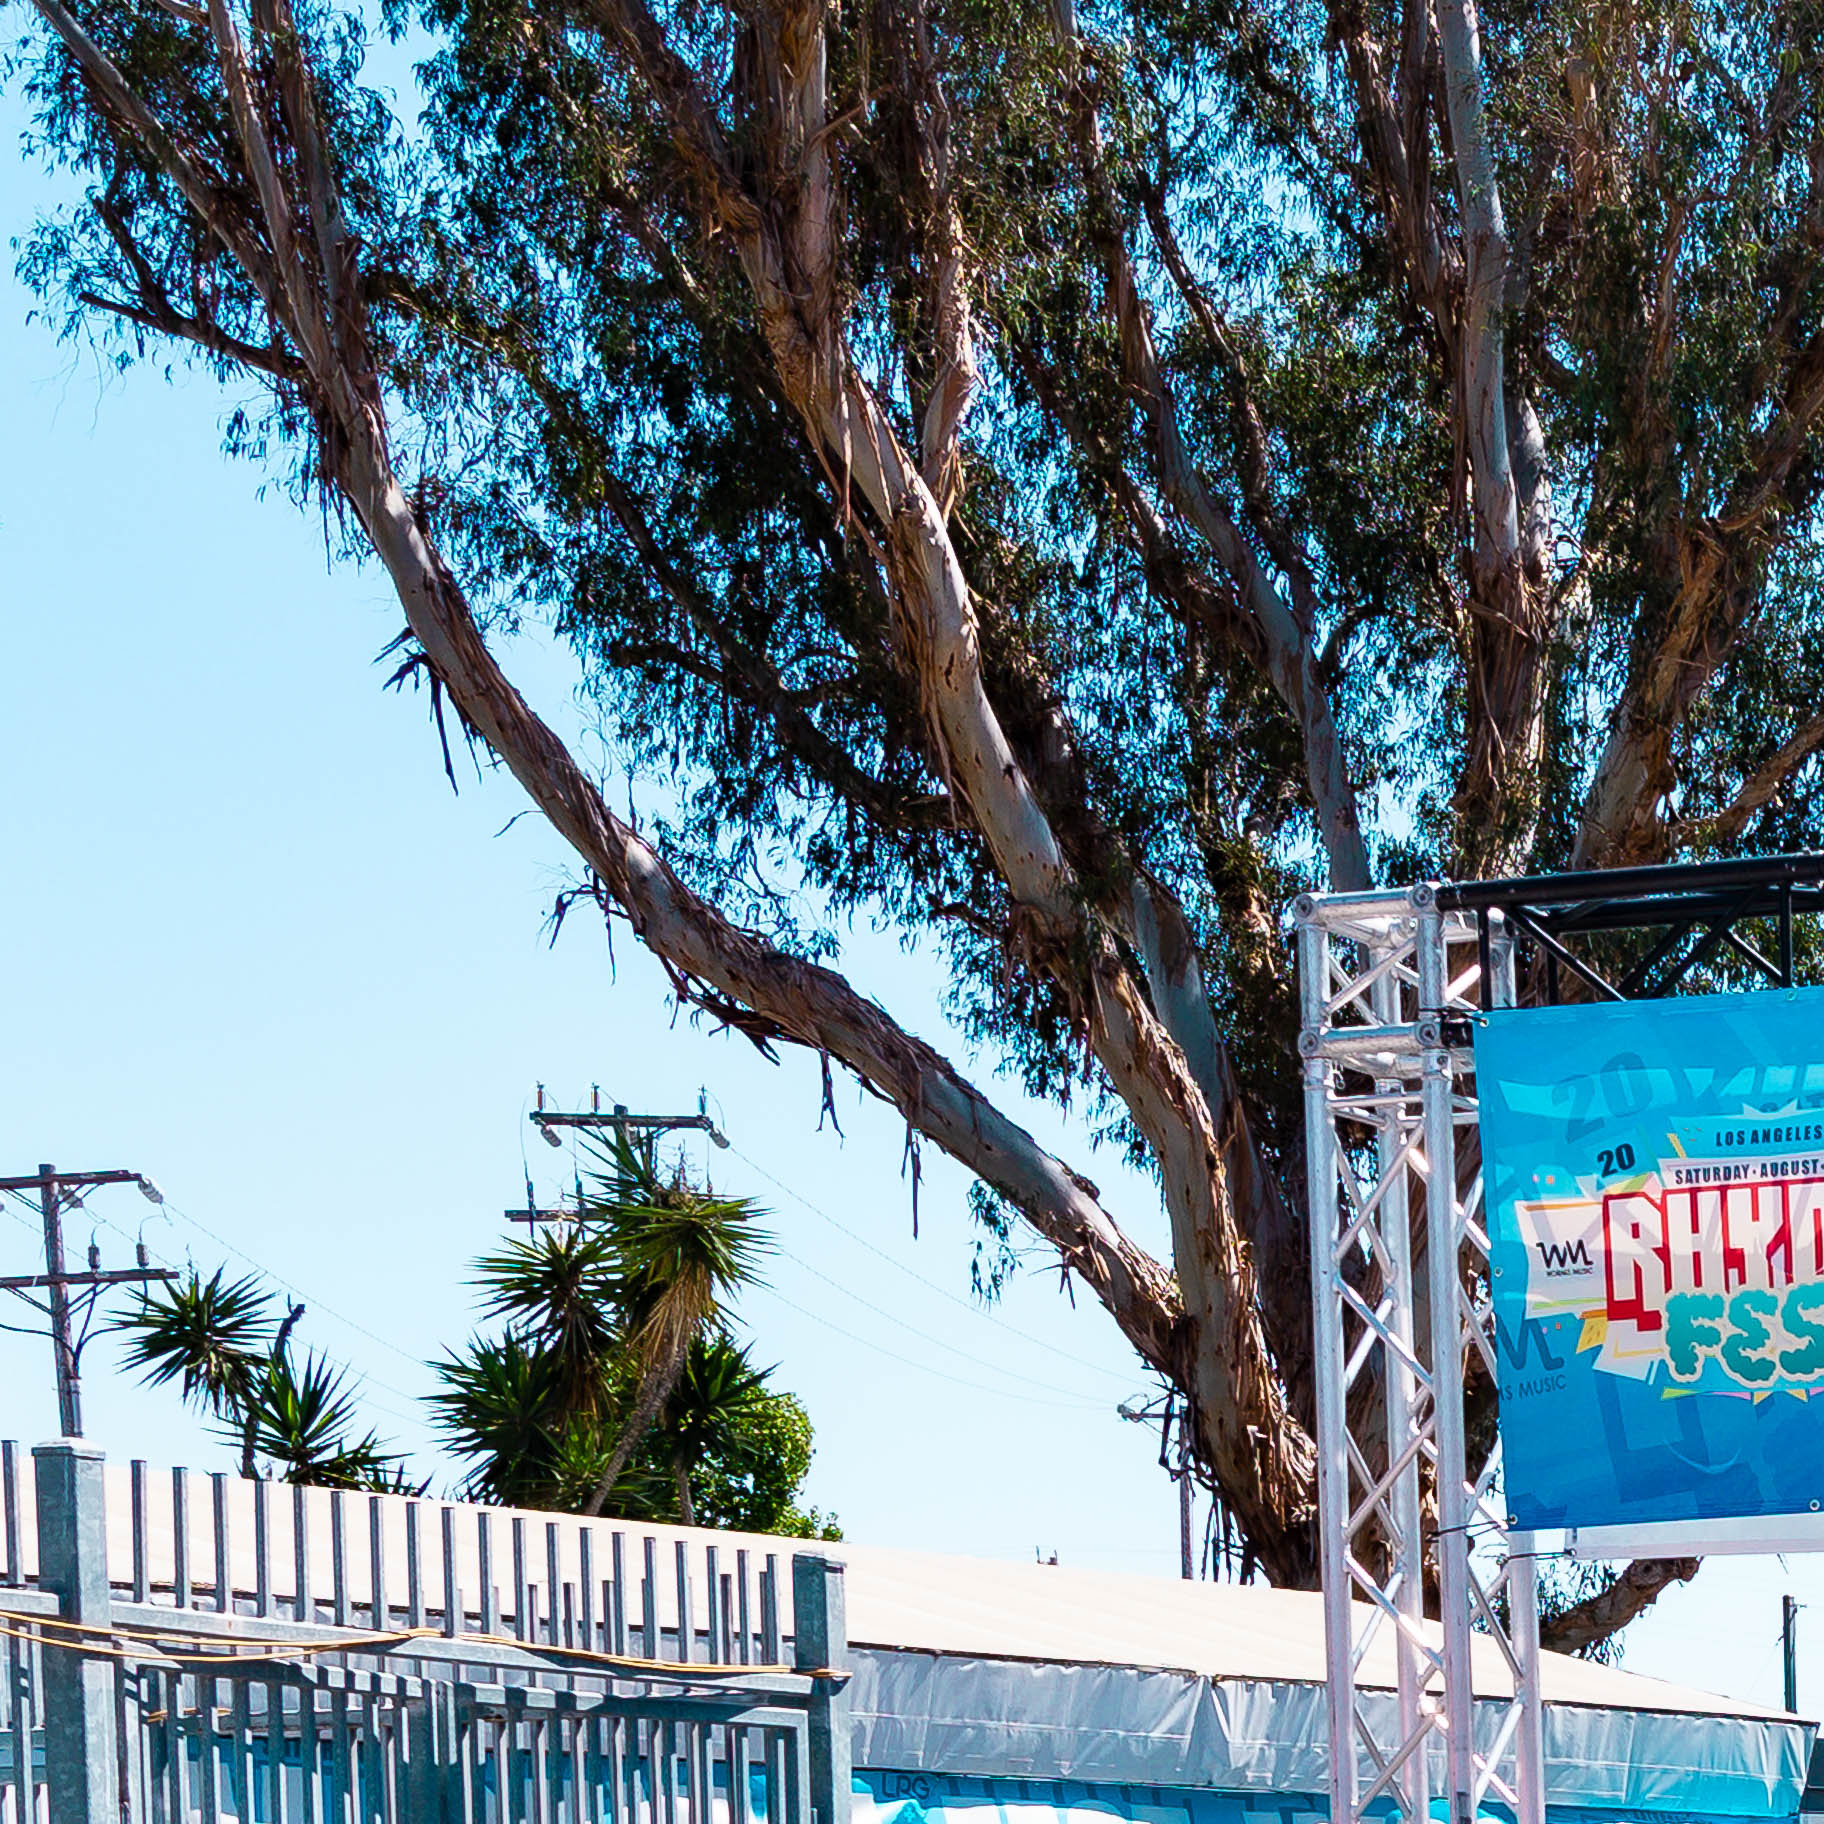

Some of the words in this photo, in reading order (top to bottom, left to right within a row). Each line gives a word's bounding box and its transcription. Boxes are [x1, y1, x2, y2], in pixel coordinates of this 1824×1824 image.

[1597, 1143, 1635, 1178] 20
[1715, 1130, 1746, 1147] LOS
[1749, 1124, 1824, 1145] ANGELES
[1674, 1163, 1750, 1184] SATURDAY
[1760, 1158, 1819, 1177] AUGUST
[1520, 1373, 1566, 1397] MUSIC
